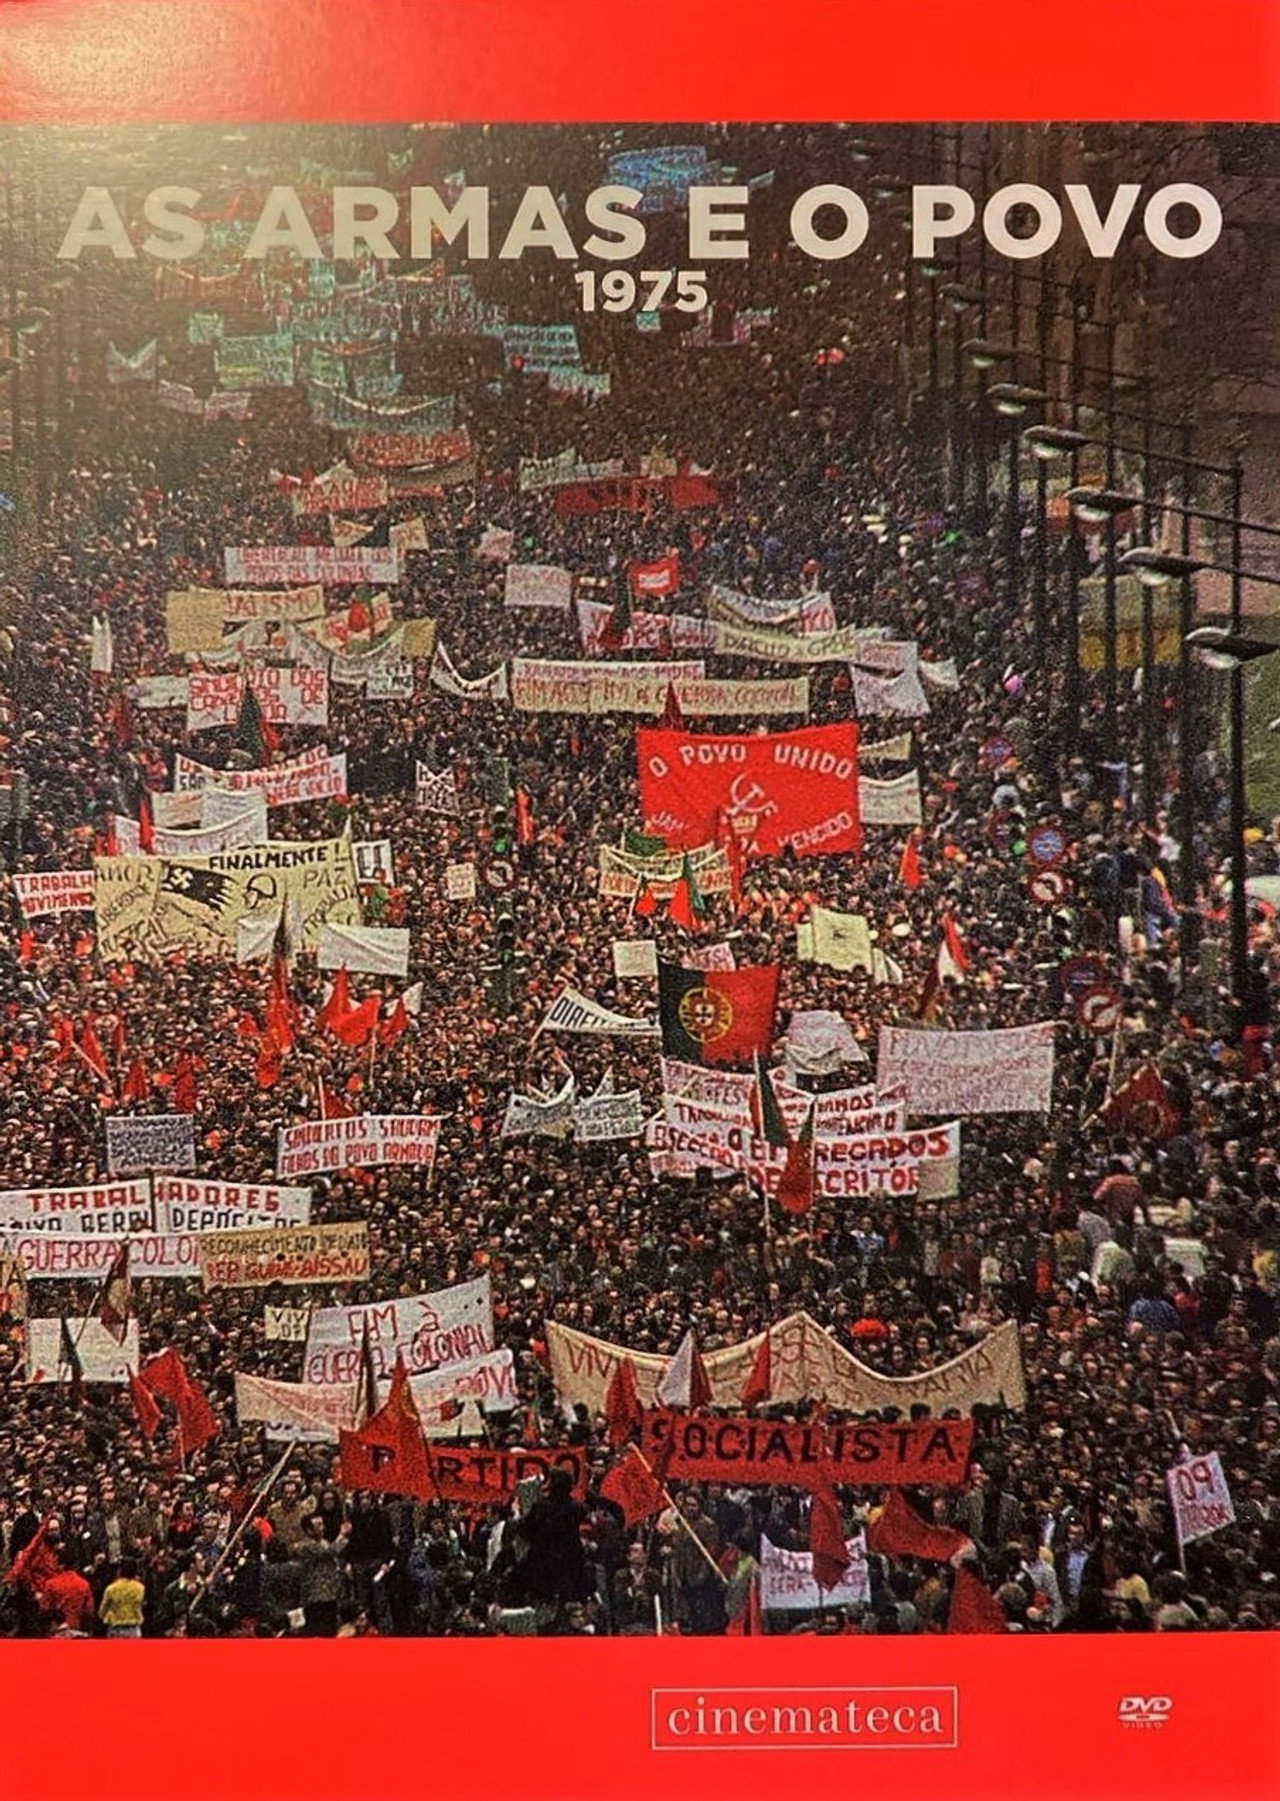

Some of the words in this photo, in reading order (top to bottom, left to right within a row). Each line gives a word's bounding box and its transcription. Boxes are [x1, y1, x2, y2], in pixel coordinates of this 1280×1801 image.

[56, 184, 203, 261] AS
[243, 184, 646, 260] ARMAS
[689, 186, 749, 259] E
[790, 184, 868, 260] O
[912, 184, 1223, 260] POVO
[575, 270, 708, 312] 1975
[678, 743, 747, 767] POVO
[773, 744, 852, 780] UNIDO
[208, 845, 329, 871] FINALMENTE
[17, 1238, 120, 1270] GUERRA
[667, 1697, 943, 1736] cinemateca
[1119, 1696, 1173, 1713] DVD
